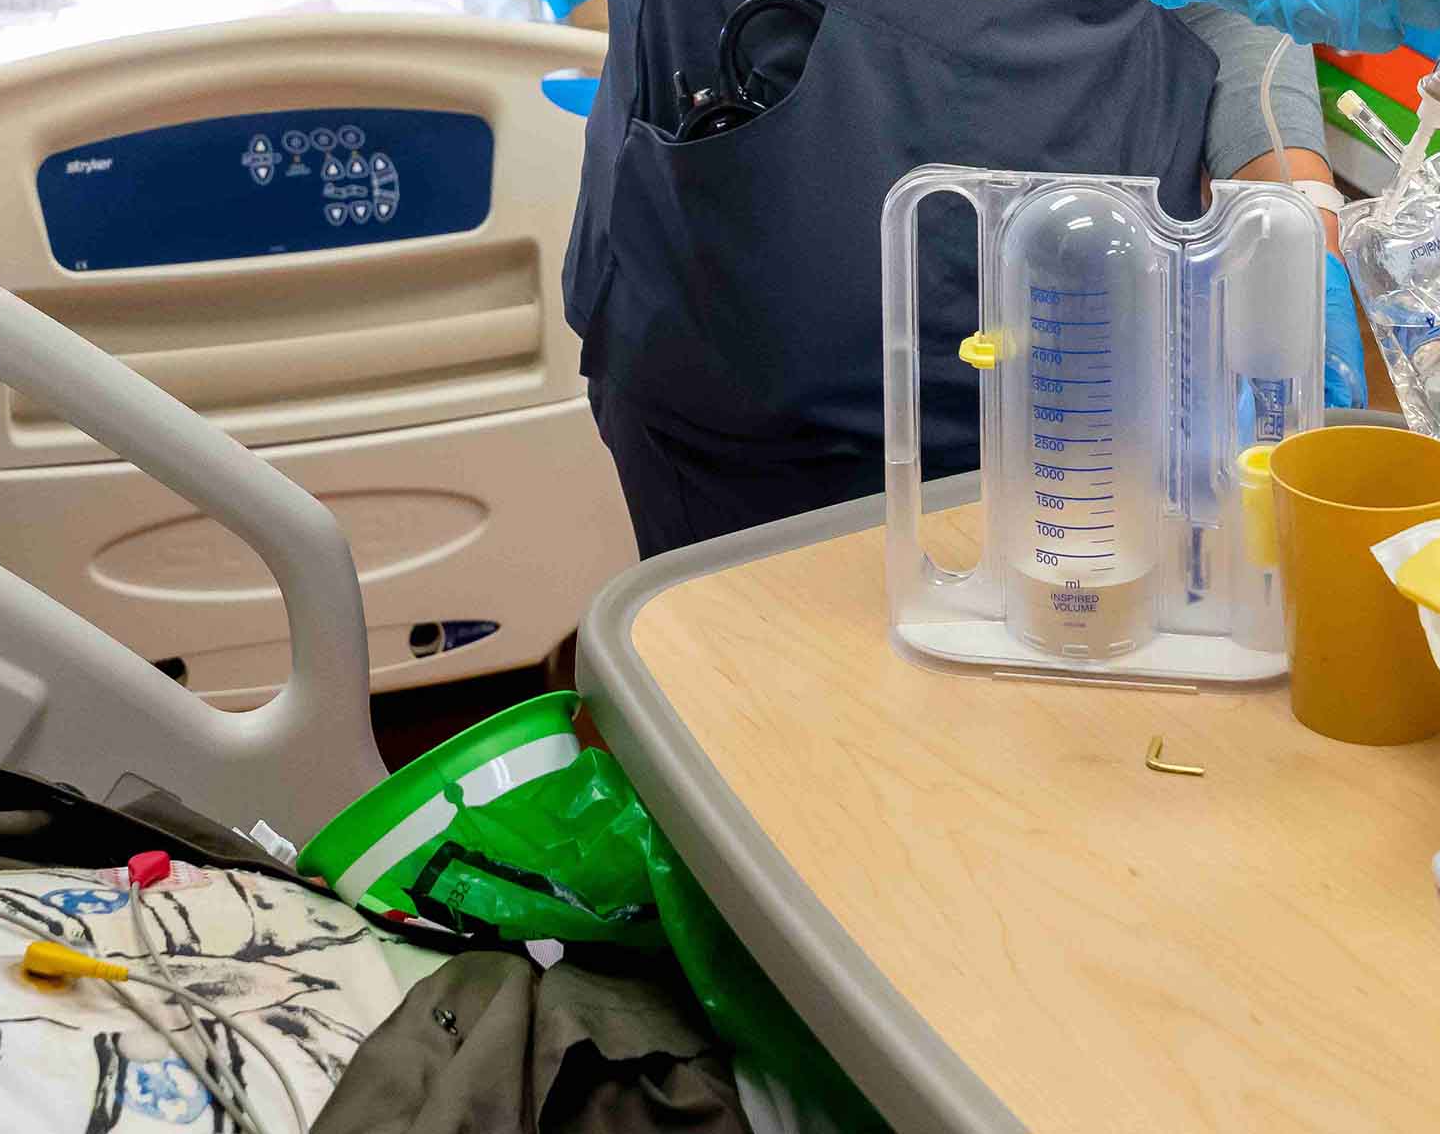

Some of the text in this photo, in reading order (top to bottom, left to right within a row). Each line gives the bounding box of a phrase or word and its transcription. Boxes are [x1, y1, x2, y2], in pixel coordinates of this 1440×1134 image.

[1032, 350, 1062, 365] 4000
[1033, 379, 1063, 394] 3500
[1033, 408, 1064, 423] 3000
[1034, 437, 1065, 452] 2500
[1034, 465, 1065, 481] 2000
[1036, 494, 1065, 511] 1500
[1036, 524, 1065, 539] 1000
[1035, 552, 1058, 567] 500
[1050, 593, 1100, 604] INSPIRED
[1053, 603, 1097, 613] VOLUME
